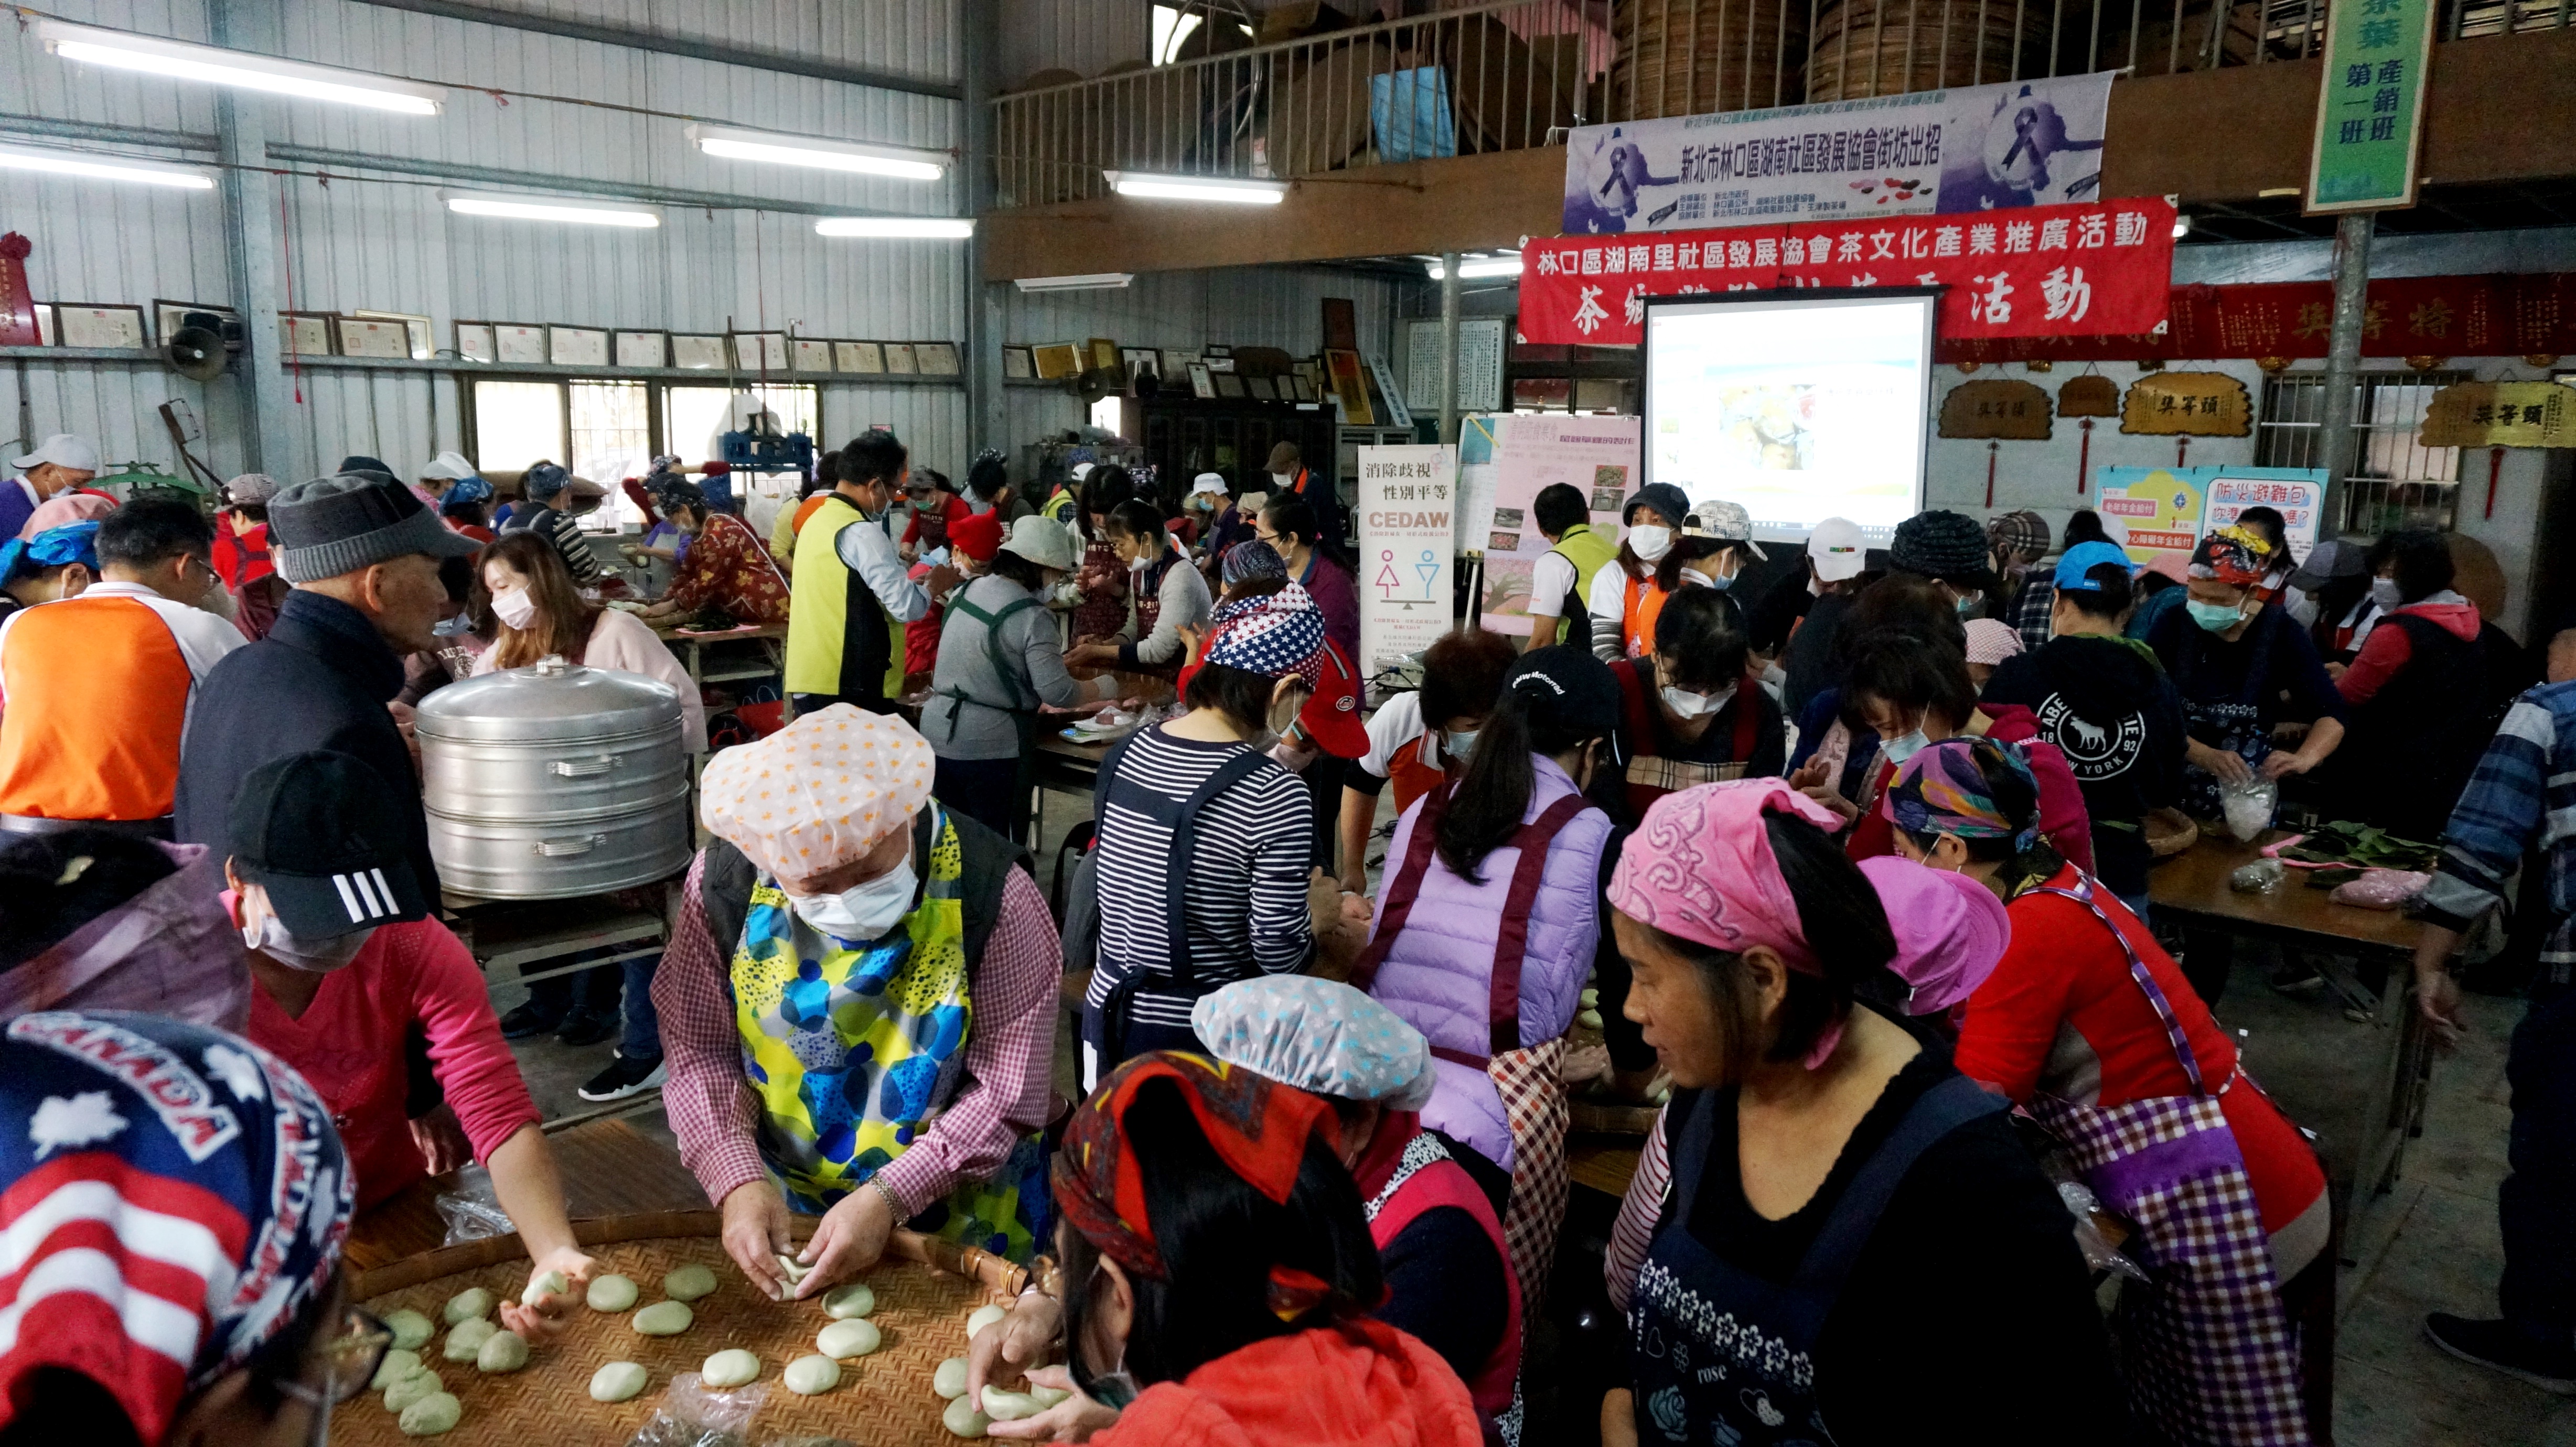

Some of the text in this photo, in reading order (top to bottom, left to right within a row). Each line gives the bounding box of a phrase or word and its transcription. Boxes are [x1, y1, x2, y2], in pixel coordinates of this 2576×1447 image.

[2339, 63, 2372, 144] 第一班
[2369, 59, 2403, 141] 產銷班
[1680, 123, 1941, 184] 新北市林口區湖南社區發展協會街坊出招
[1537, 211, 2148, 276] 林口區湖南里社區發展協會茶文化產業推廣活動
[1366, 462, 1431, 478] 消除歧視
[1382, 484, 1448, 500] 性別平等
[2216, 482, 2306, 504] 防災避難包
[2106, 502, 2153, 514] 老年年金給付
[1368, 511, 1450, 528] CEDAW
[1531, 671, 1565, 695] Motorrad
[2123, 740, 2136, 751] 92
[2084, 756, 2124, 774] YORK
[1697, 1364, 1727, 1384] rose
